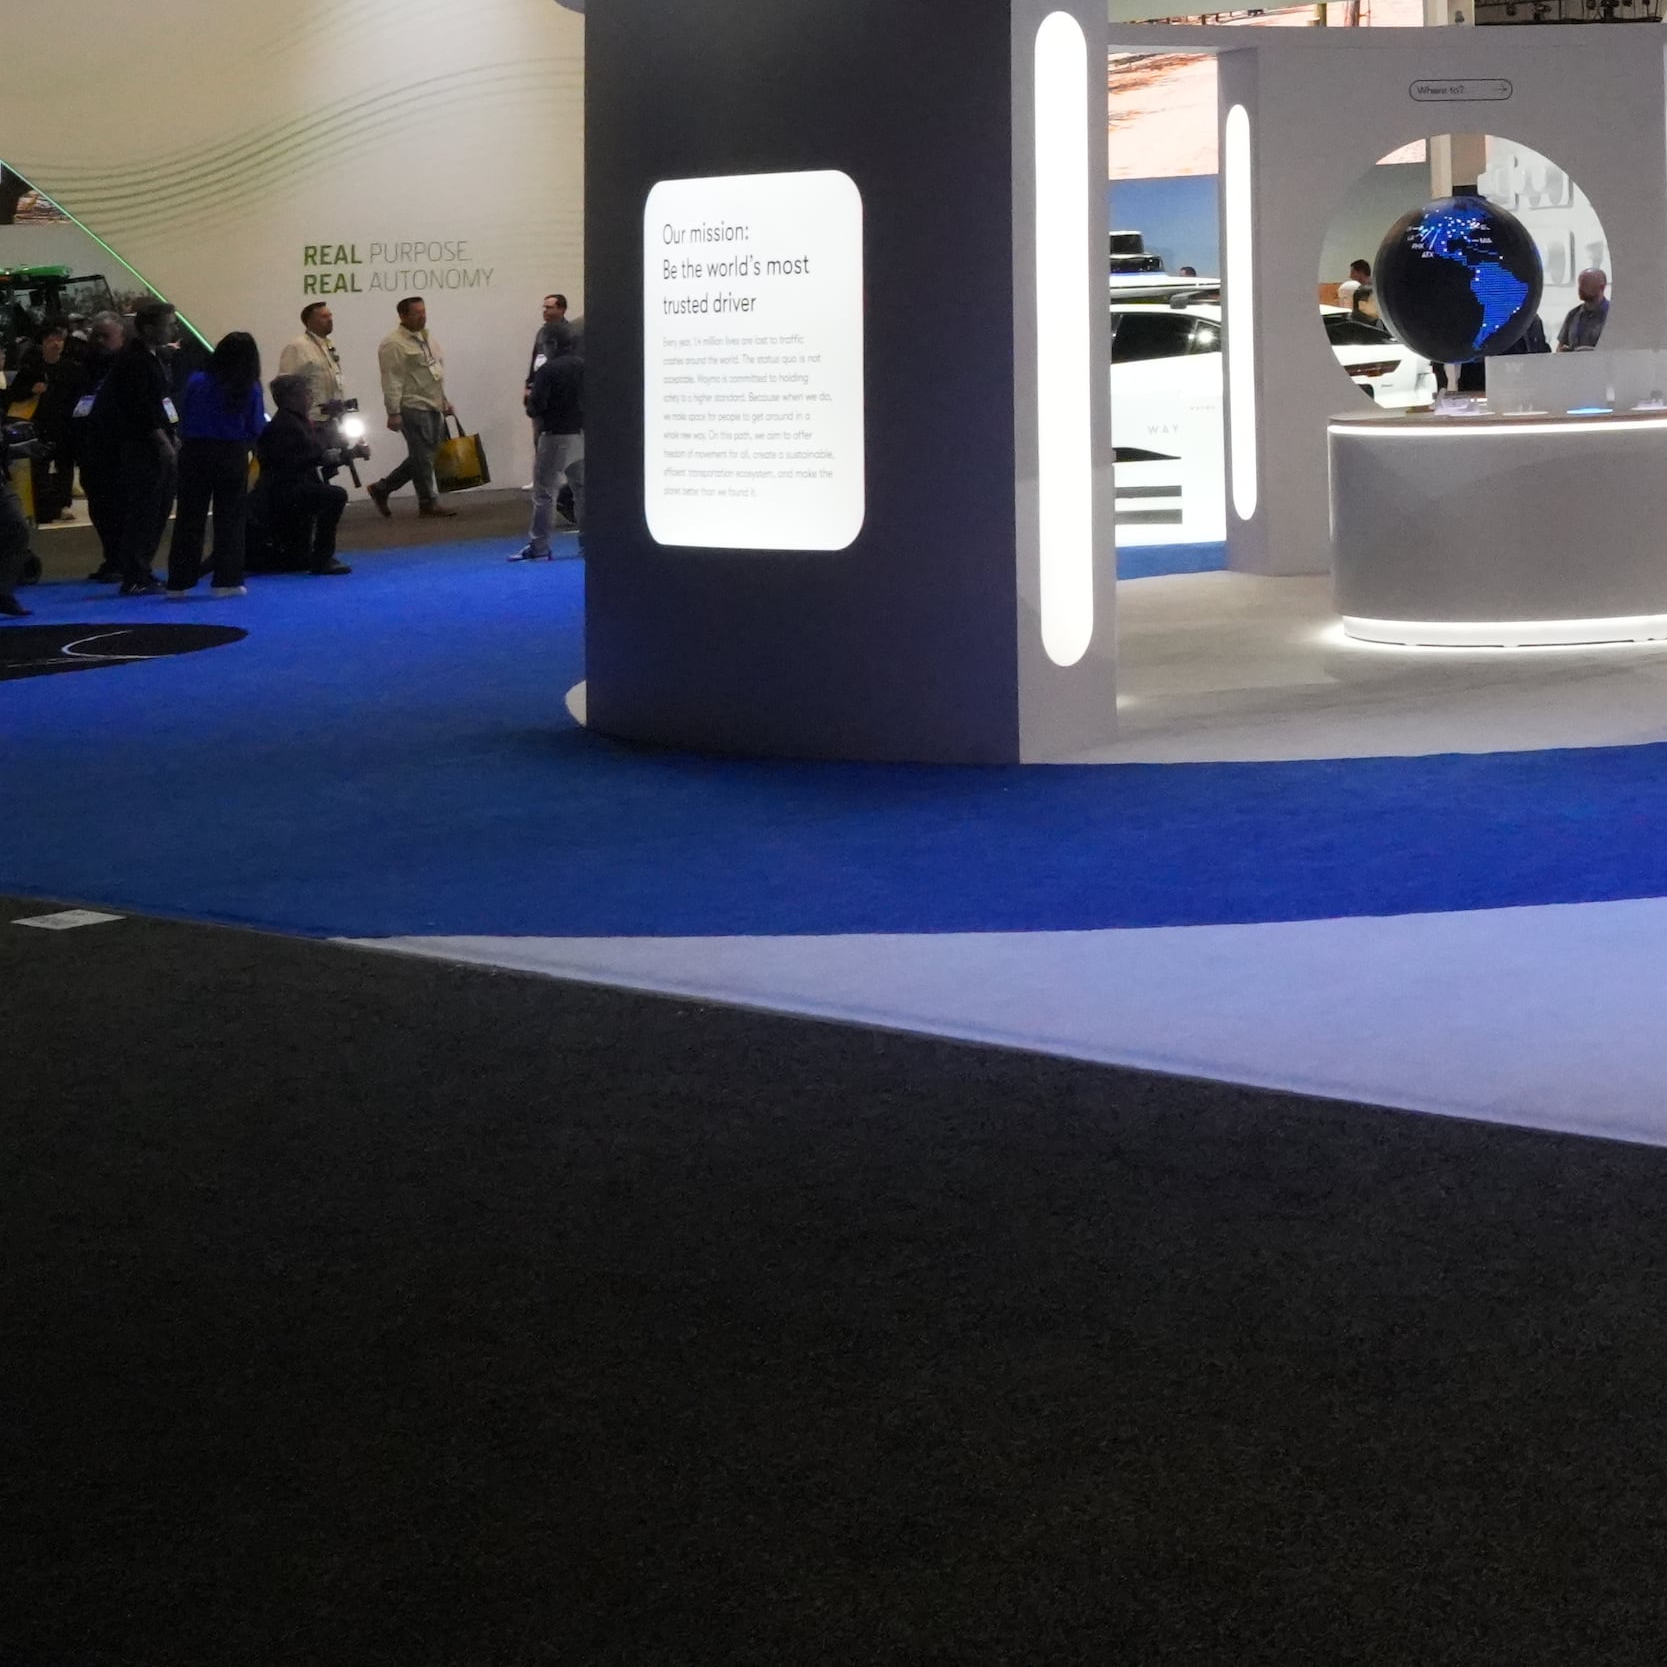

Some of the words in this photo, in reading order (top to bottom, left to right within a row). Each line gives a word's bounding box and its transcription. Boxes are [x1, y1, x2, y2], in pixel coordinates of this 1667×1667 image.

[664, 223, 686, 245] Our
[690, 220, 749, 243] mission:
[304, 244, 363, 266] REAL
[664, 259, 678, 280] Be
[682, 256, 702, 279] the
[707, 254, 761, 277] world’s
[767, 255, 810, 276] most
[304, 272, 363, 295] REAL
[664, 292, 708, 315] trusted
[713, 291, 756, 313] driver
